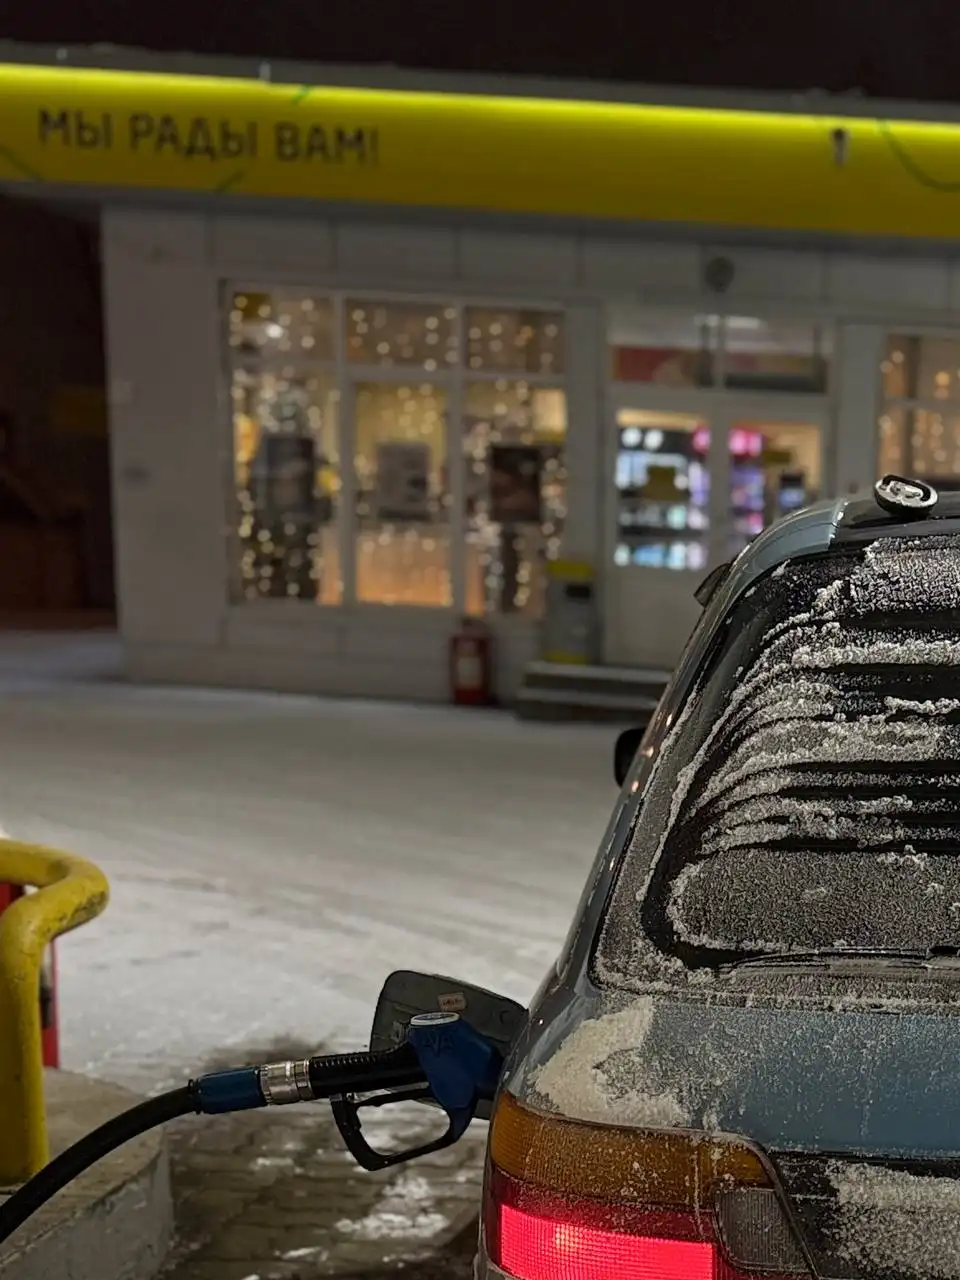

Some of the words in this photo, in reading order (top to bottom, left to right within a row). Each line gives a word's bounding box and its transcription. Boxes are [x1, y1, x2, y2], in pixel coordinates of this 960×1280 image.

[38, 108, 114, 150] МЫ
[128, 111, 258, 161] РАДЫ
[273, 120, 381, 165] ВАМ!
